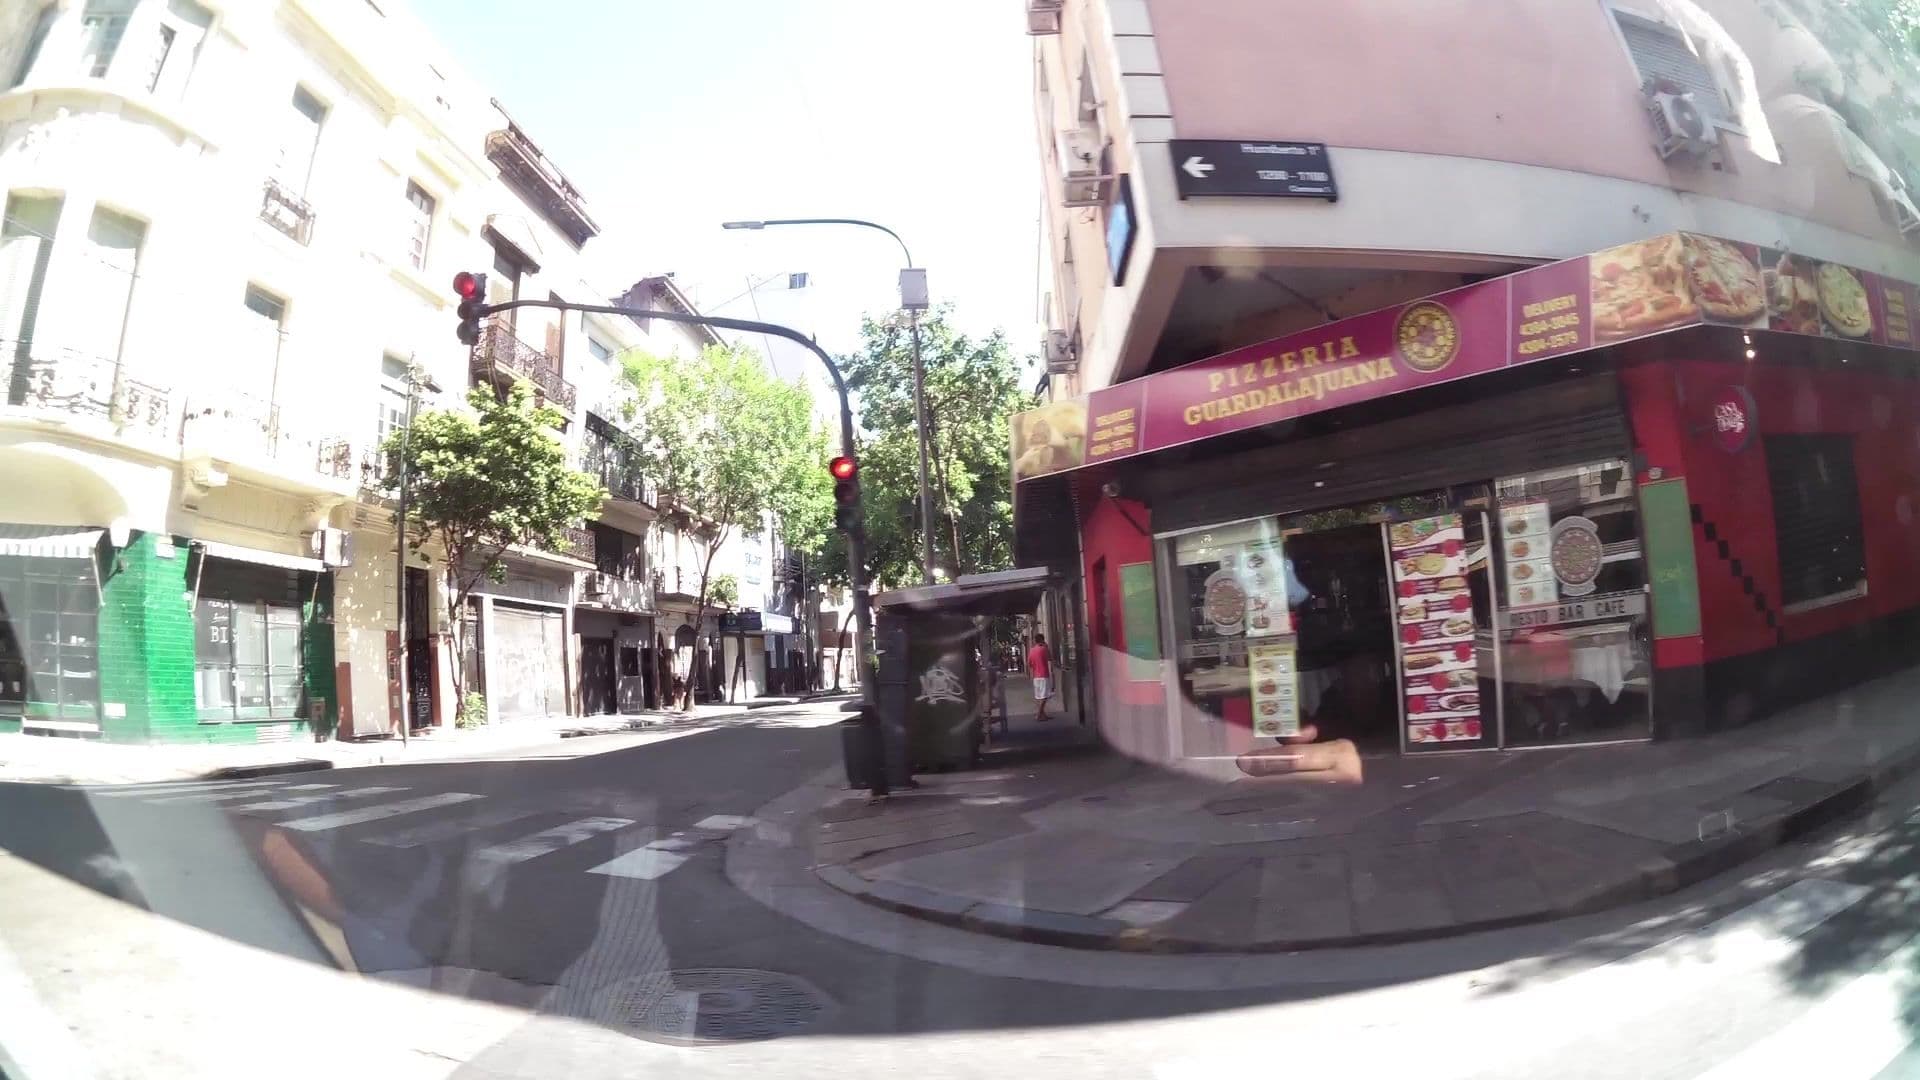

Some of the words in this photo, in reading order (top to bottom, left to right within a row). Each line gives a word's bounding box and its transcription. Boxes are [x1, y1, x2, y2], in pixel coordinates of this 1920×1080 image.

[1184, 357, 1399, 426] GUARDALAJUANA
[1208, 336, 1361, 393] PIZZERIA
[1559, 605, 1585, 621] BAR
